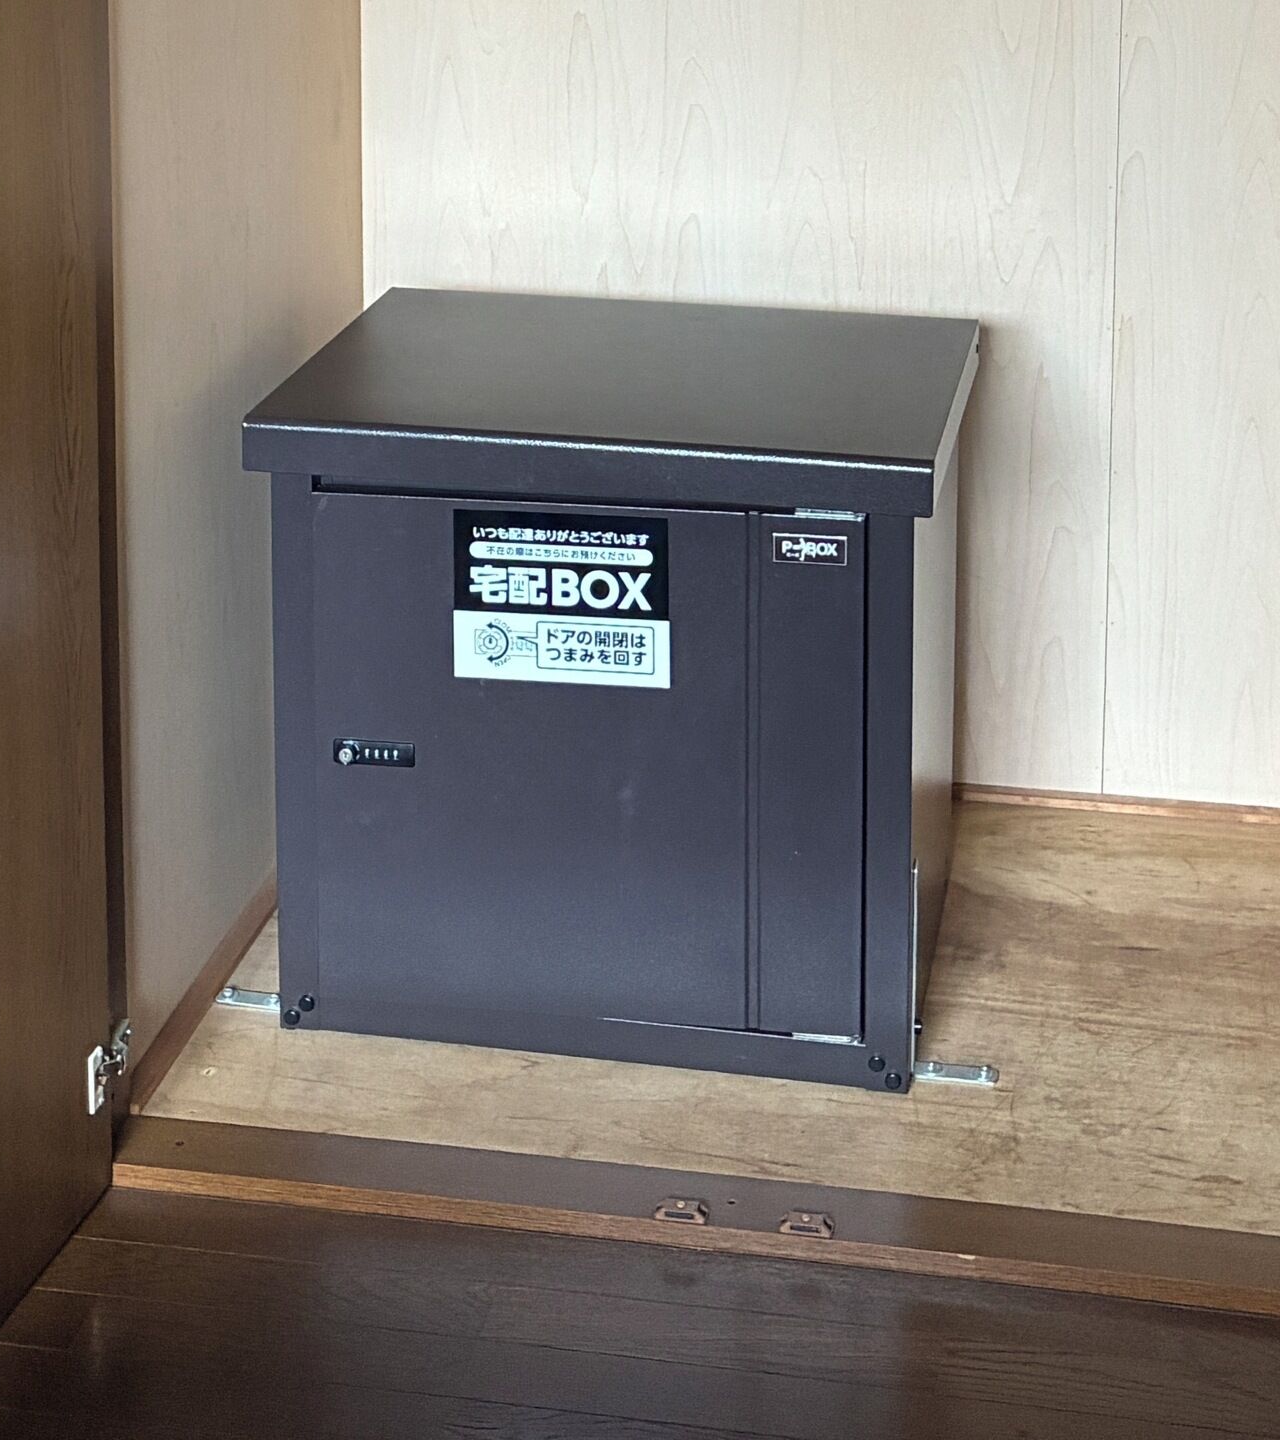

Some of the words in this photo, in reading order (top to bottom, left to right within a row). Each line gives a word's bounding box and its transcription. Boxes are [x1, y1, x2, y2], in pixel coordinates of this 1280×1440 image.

[472, 526, 649, 546] いつも配達ありがとうございます
[469, 565, 652, 611] 宅配BOX
[546, 627, 647, 649] ドアの開閉は
[545, 647, 647, 667] つまみを回す
